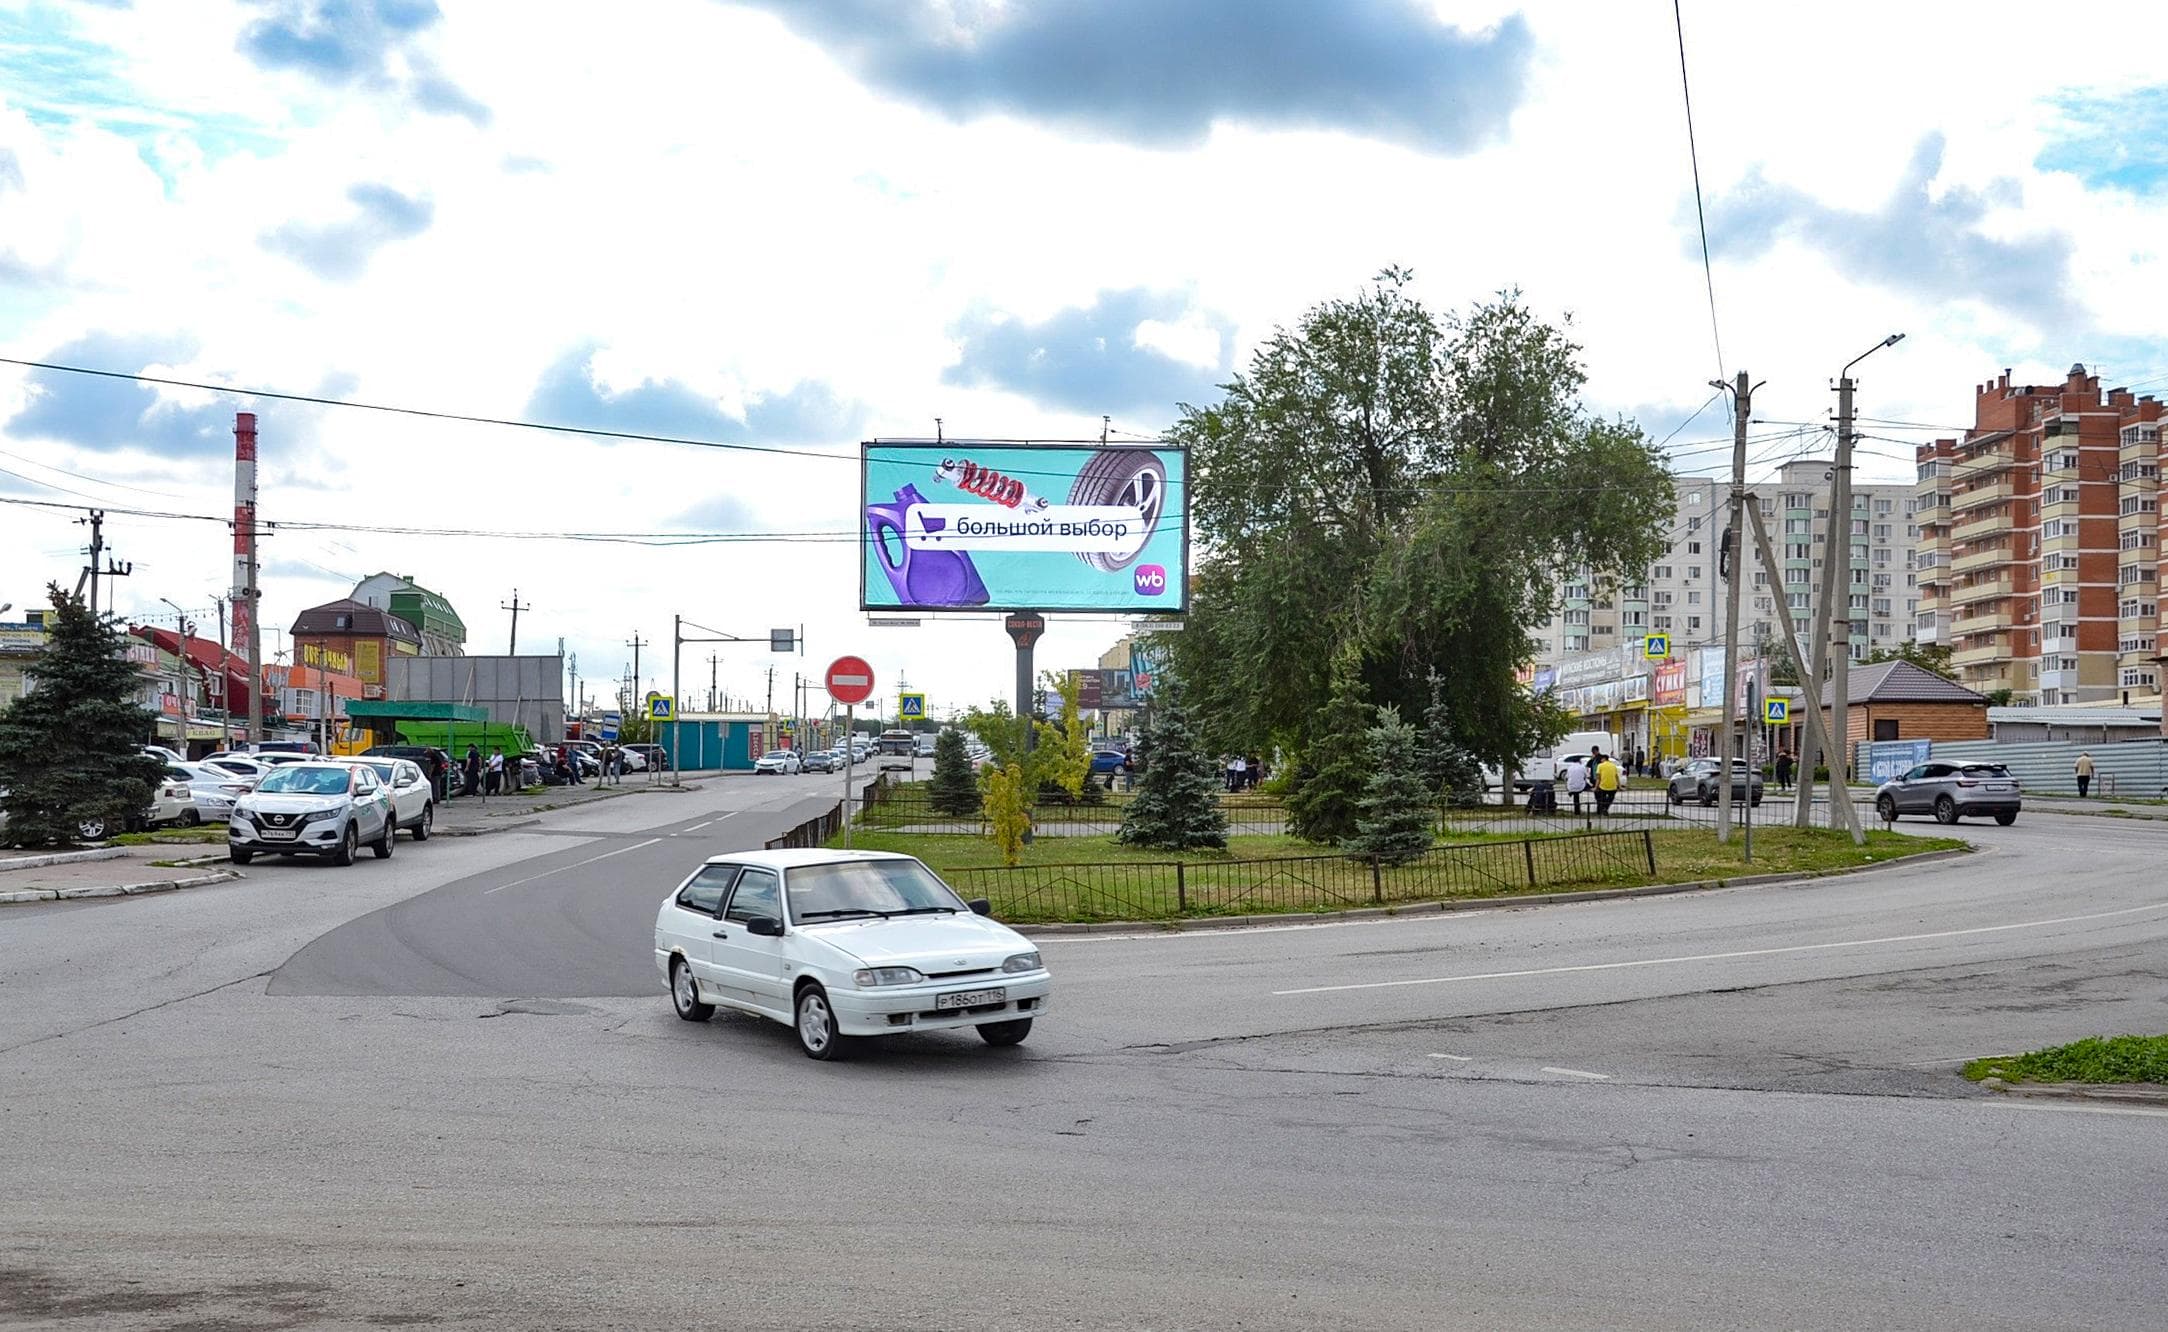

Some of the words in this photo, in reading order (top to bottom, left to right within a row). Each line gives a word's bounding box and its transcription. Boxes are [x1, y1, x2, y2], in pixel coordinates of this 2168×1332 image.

[957, 517, 1053, 536] большой
[1060, 519, 1127, 540] выбор
[1136, 573, 1164, 588] wb
[1656, 670, 1685, 693] СУМКИ
